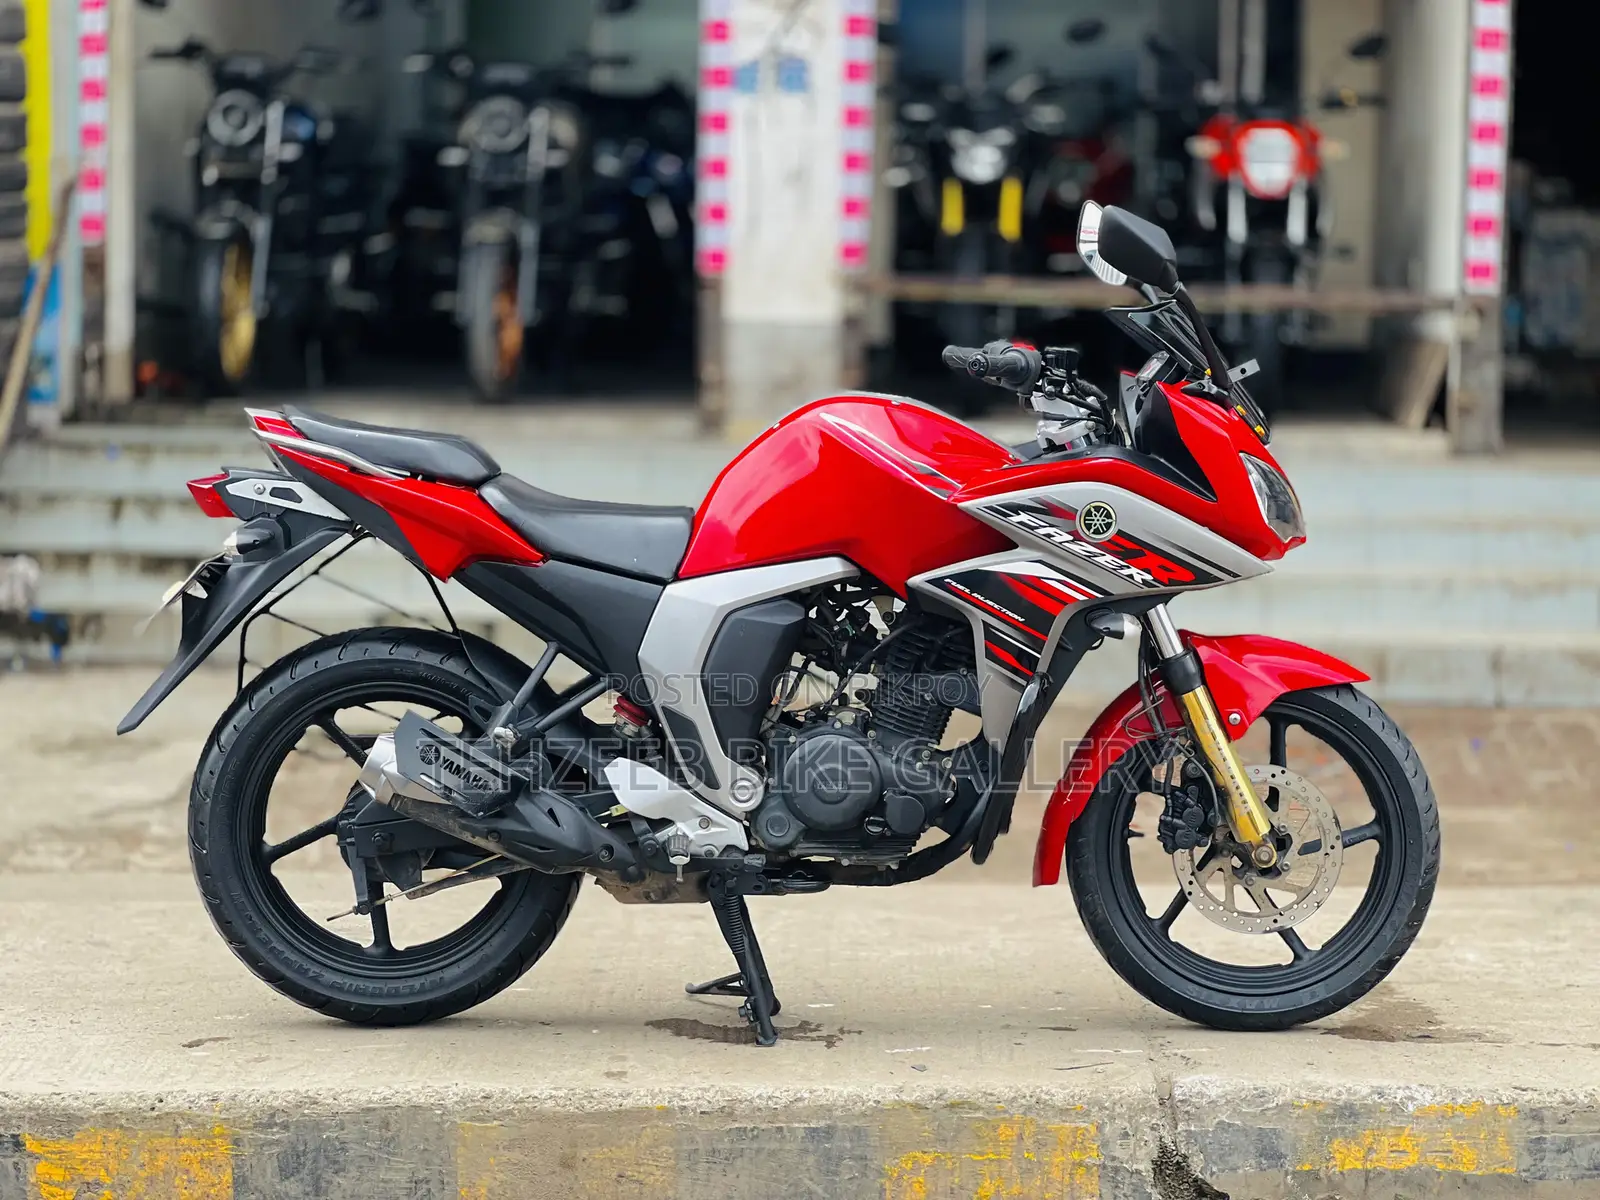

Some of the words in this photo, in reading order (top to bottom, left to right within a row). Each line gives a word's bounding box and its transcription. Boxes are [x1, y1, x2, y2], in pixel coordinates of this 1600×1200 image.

[1008, 510, 1154, 584] FAZER
[944, 578, 971, 594] FUEL
[971, 592, 1025, 622] INJECTION
[440, 755, 500, 791] YAMAHA
